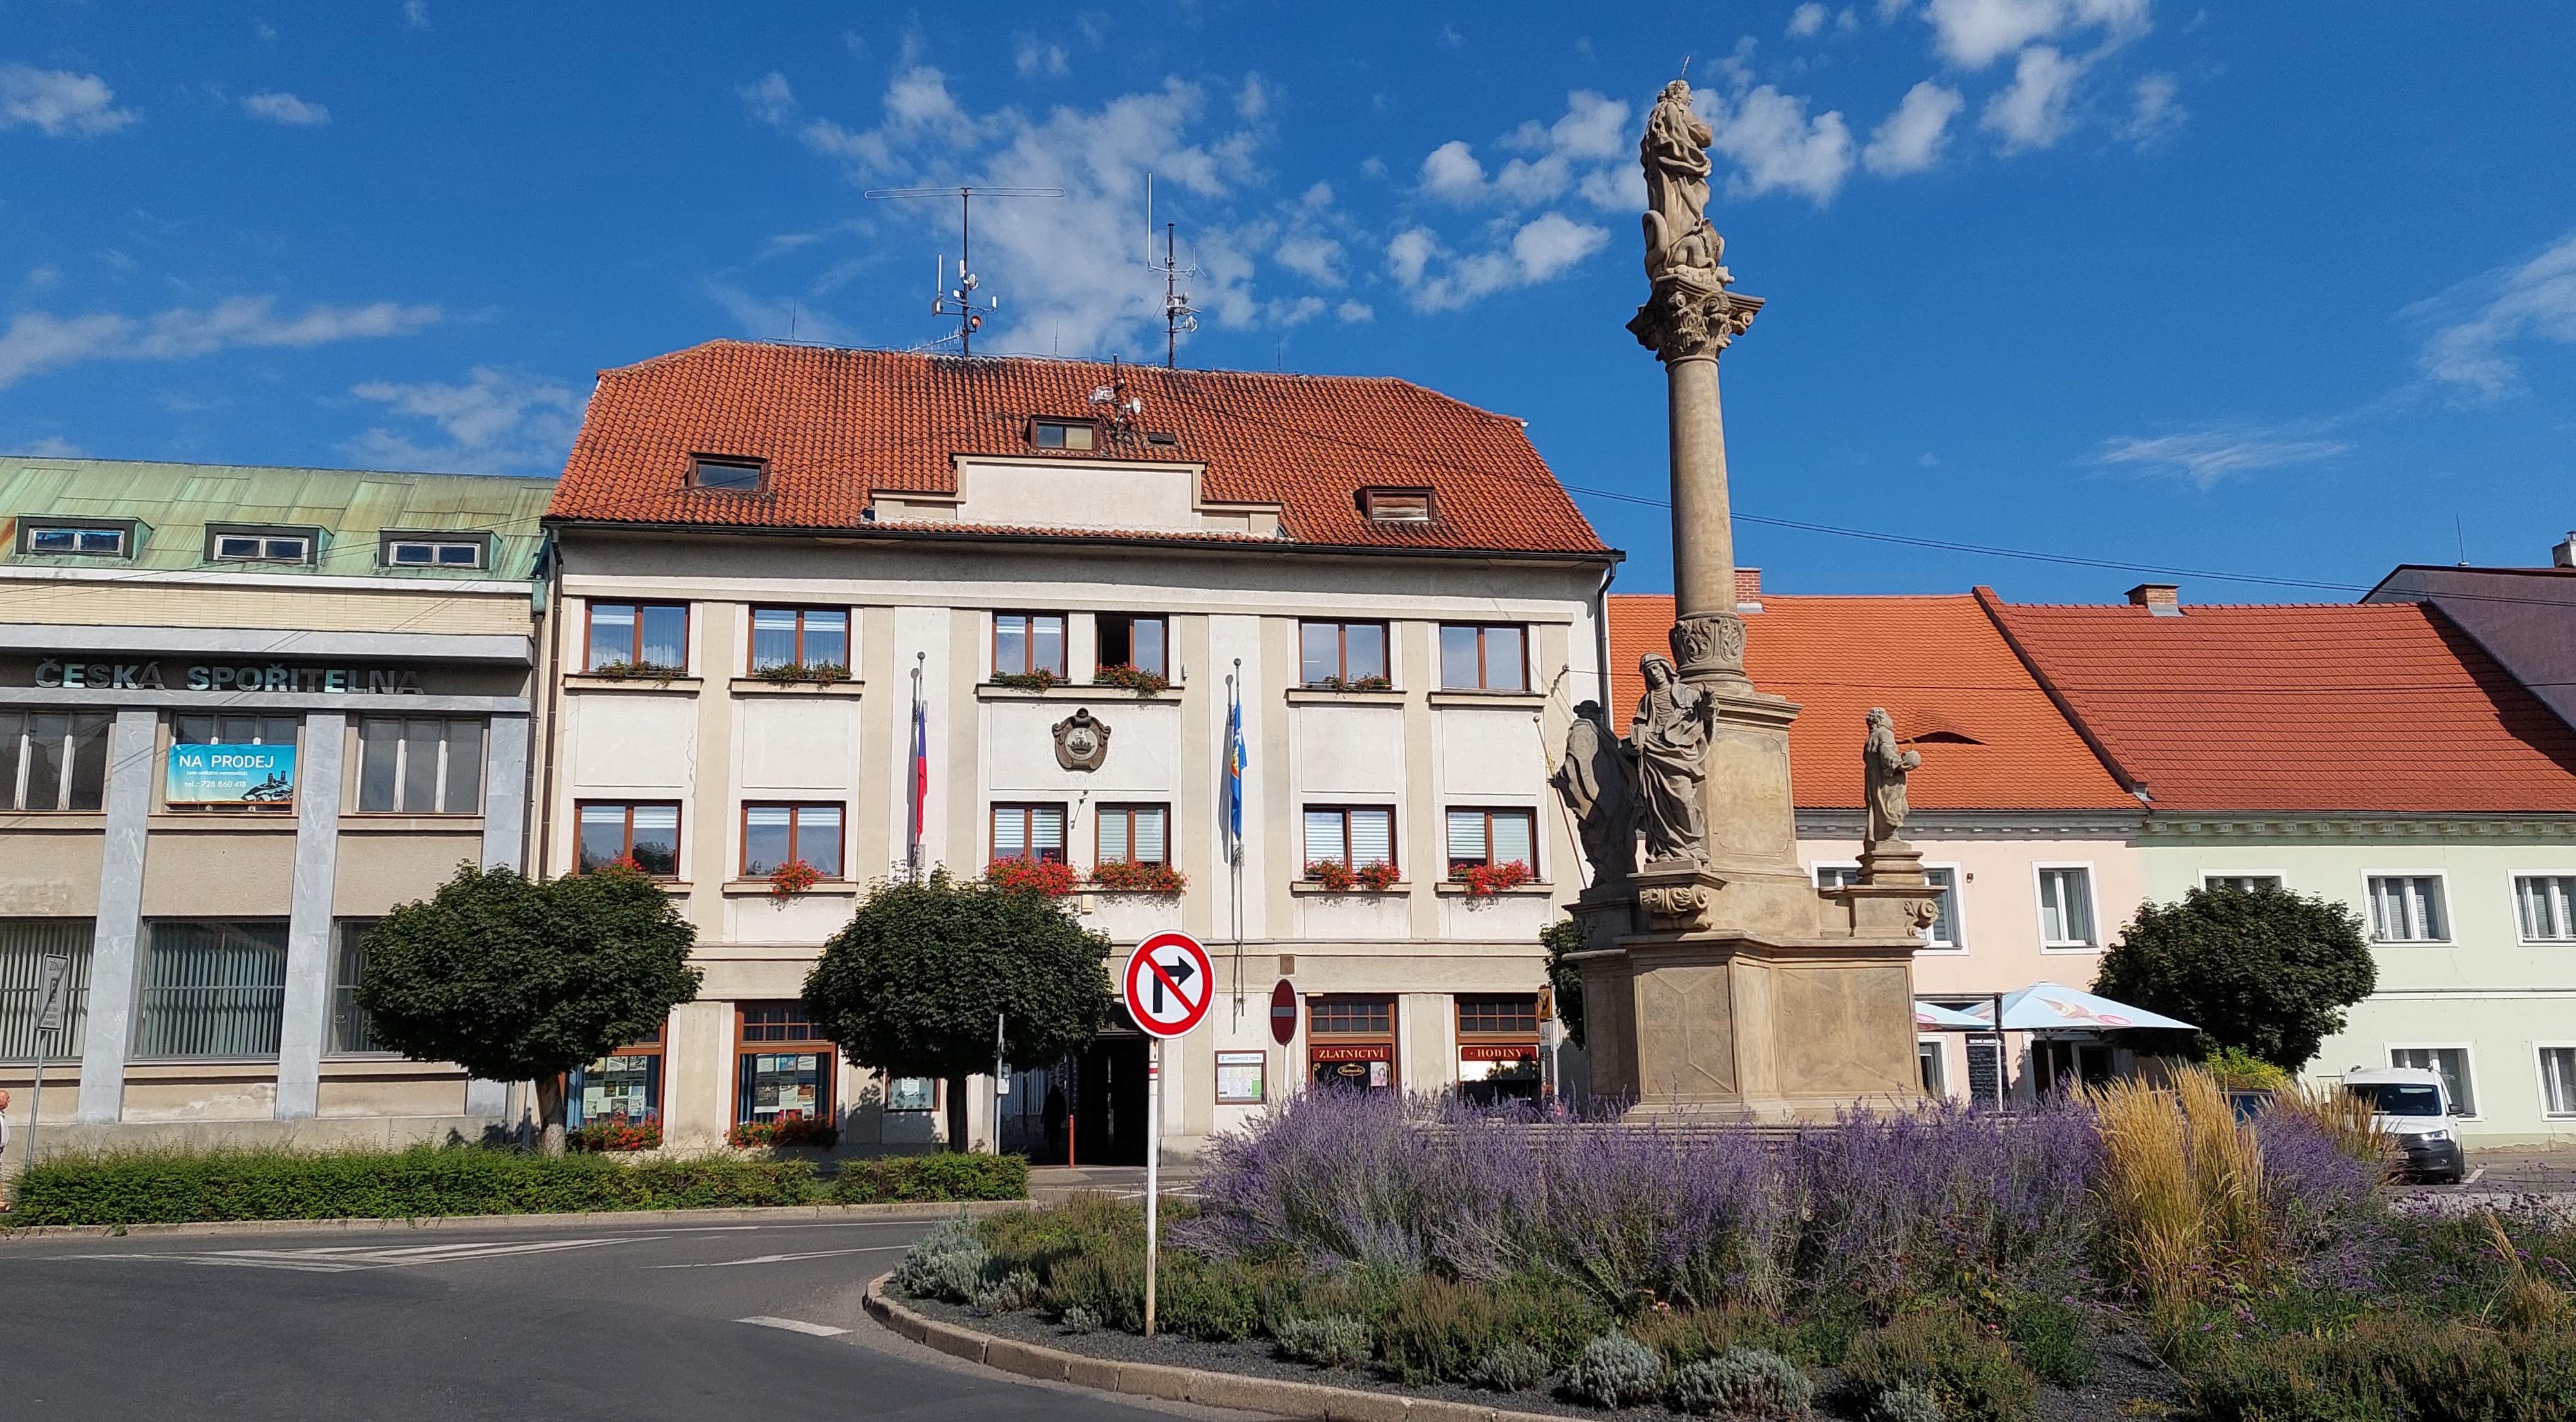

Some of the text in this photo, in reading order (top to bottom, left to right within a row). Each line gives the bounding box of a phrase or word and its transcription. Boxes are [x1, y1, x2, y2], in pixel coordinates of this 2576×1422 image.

[35, 658, 425, 694] ČESKÁ SPOŘITELNA
[179, 755, 274, 768] NA PRODEJ
[1319, 1047, 1384, 1058] ZLATNICTVÍ
